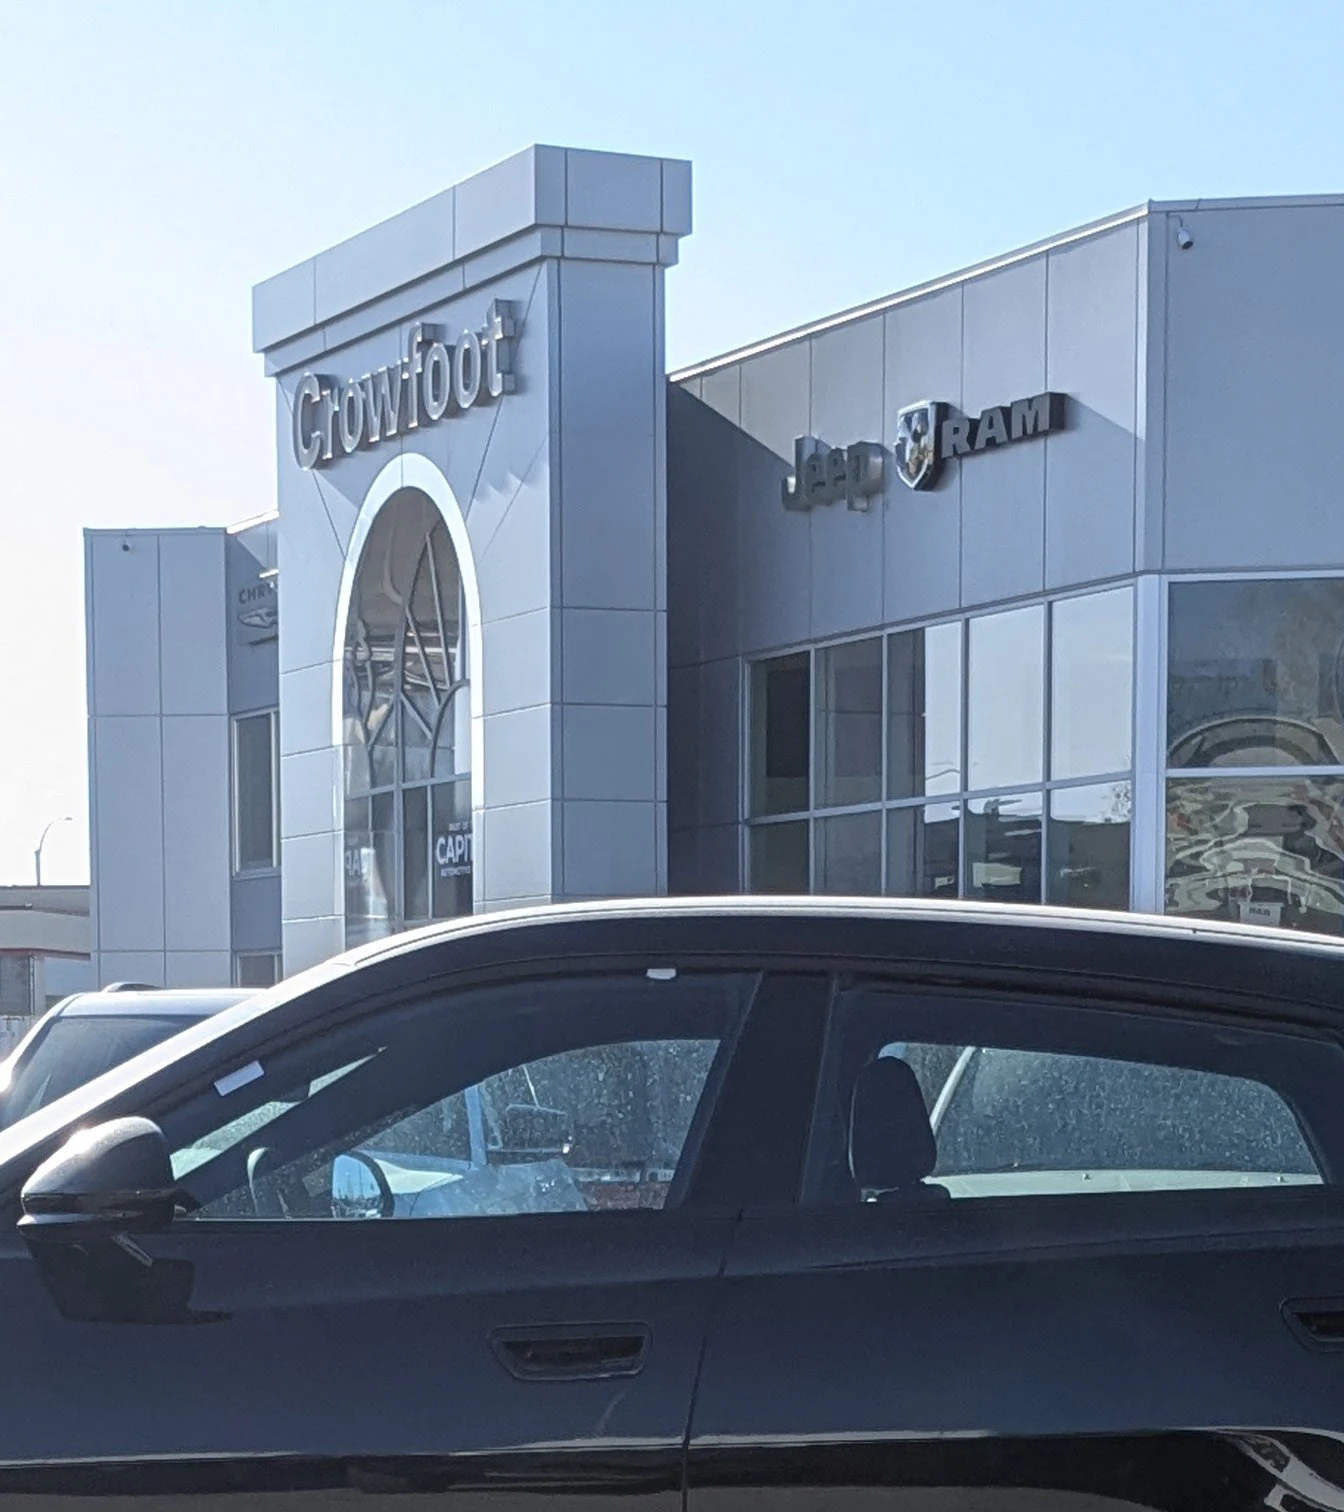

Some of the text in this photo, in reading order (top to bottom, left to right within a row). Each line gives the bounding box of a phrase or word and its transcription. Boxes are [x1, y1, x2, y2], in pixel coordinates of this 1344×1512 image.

[292, 298, 515, 472] Crowfoot
[941, 391, 1064, 460] RAM
[781, 434, 885, 513] Jeep
